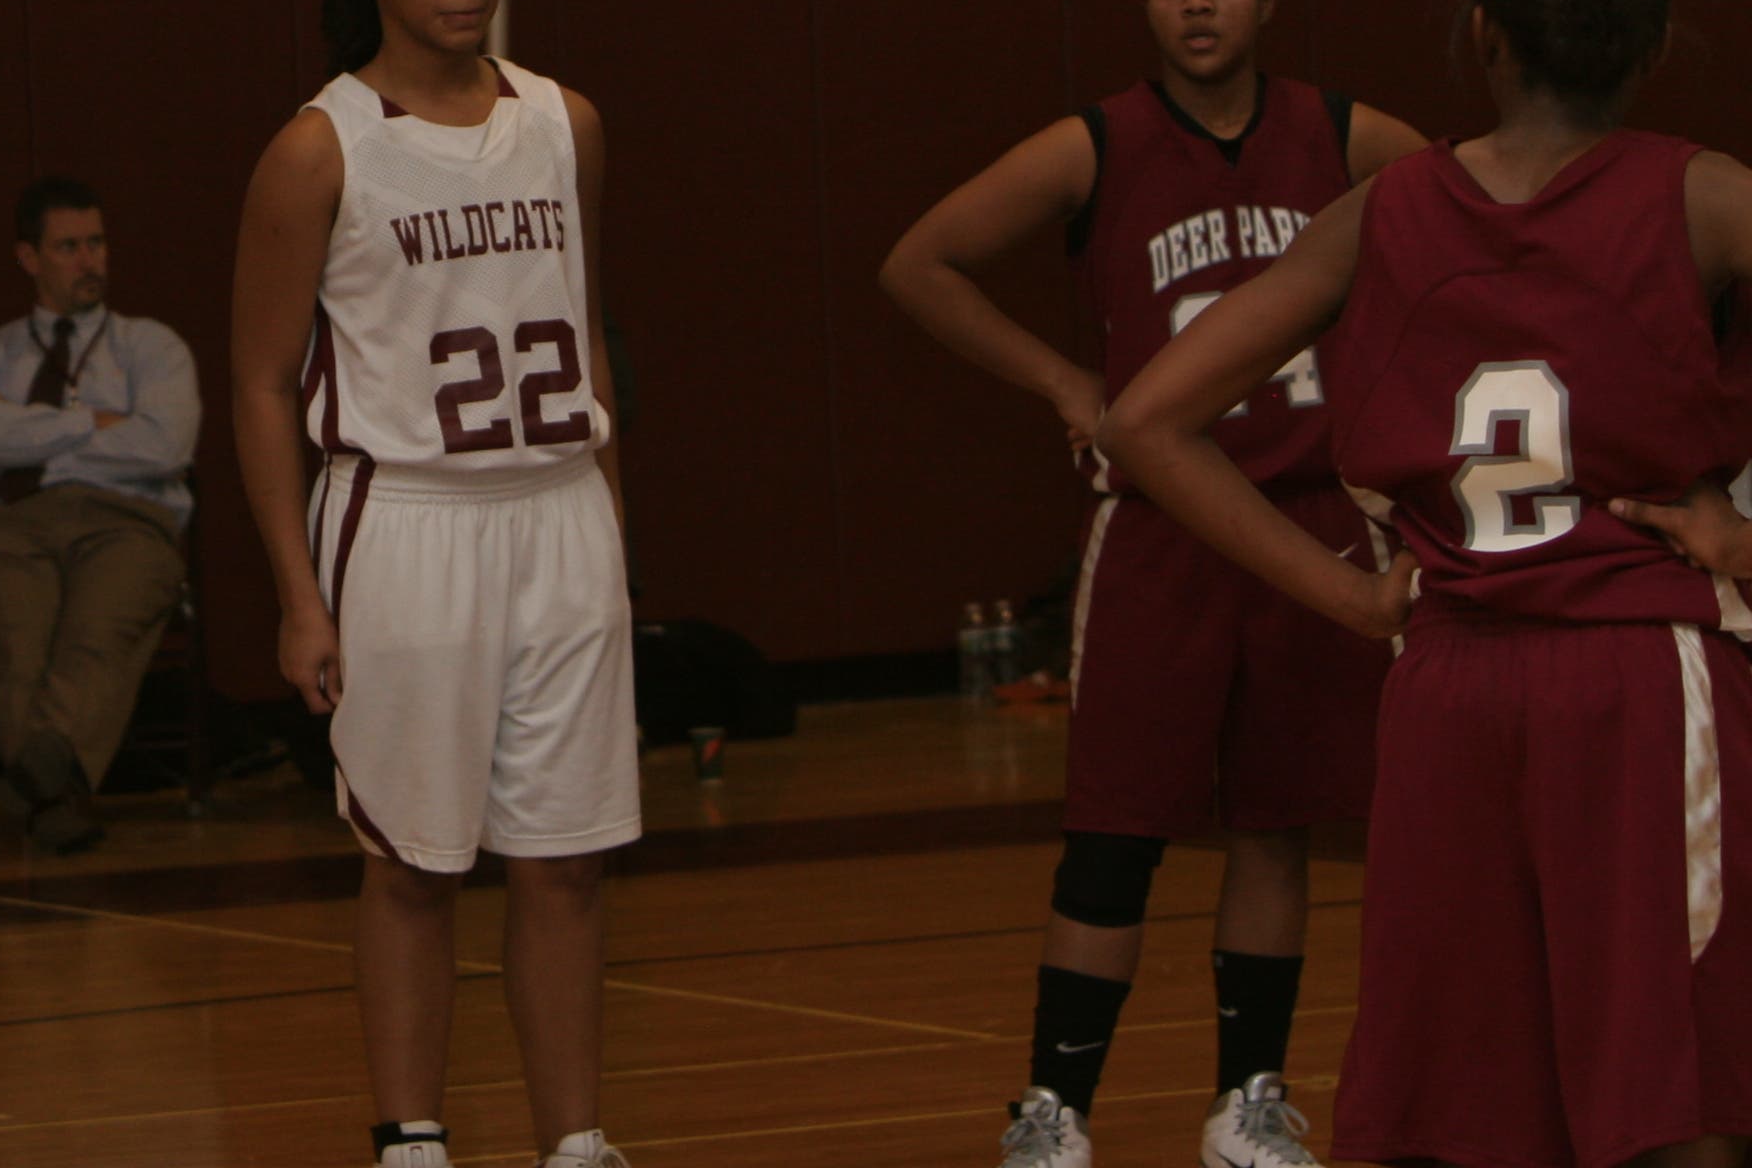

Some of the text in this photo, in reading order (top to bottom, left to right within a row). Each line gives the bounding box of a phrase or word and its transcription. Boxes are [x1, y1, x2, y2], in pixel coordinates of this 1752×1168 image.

[390, 198, 564, 266] WILDCATS
[1148, 208, 1232, 294] DEER
[429, 319, 591, 454] 22
[1448, 360, 1581, 553] 2
